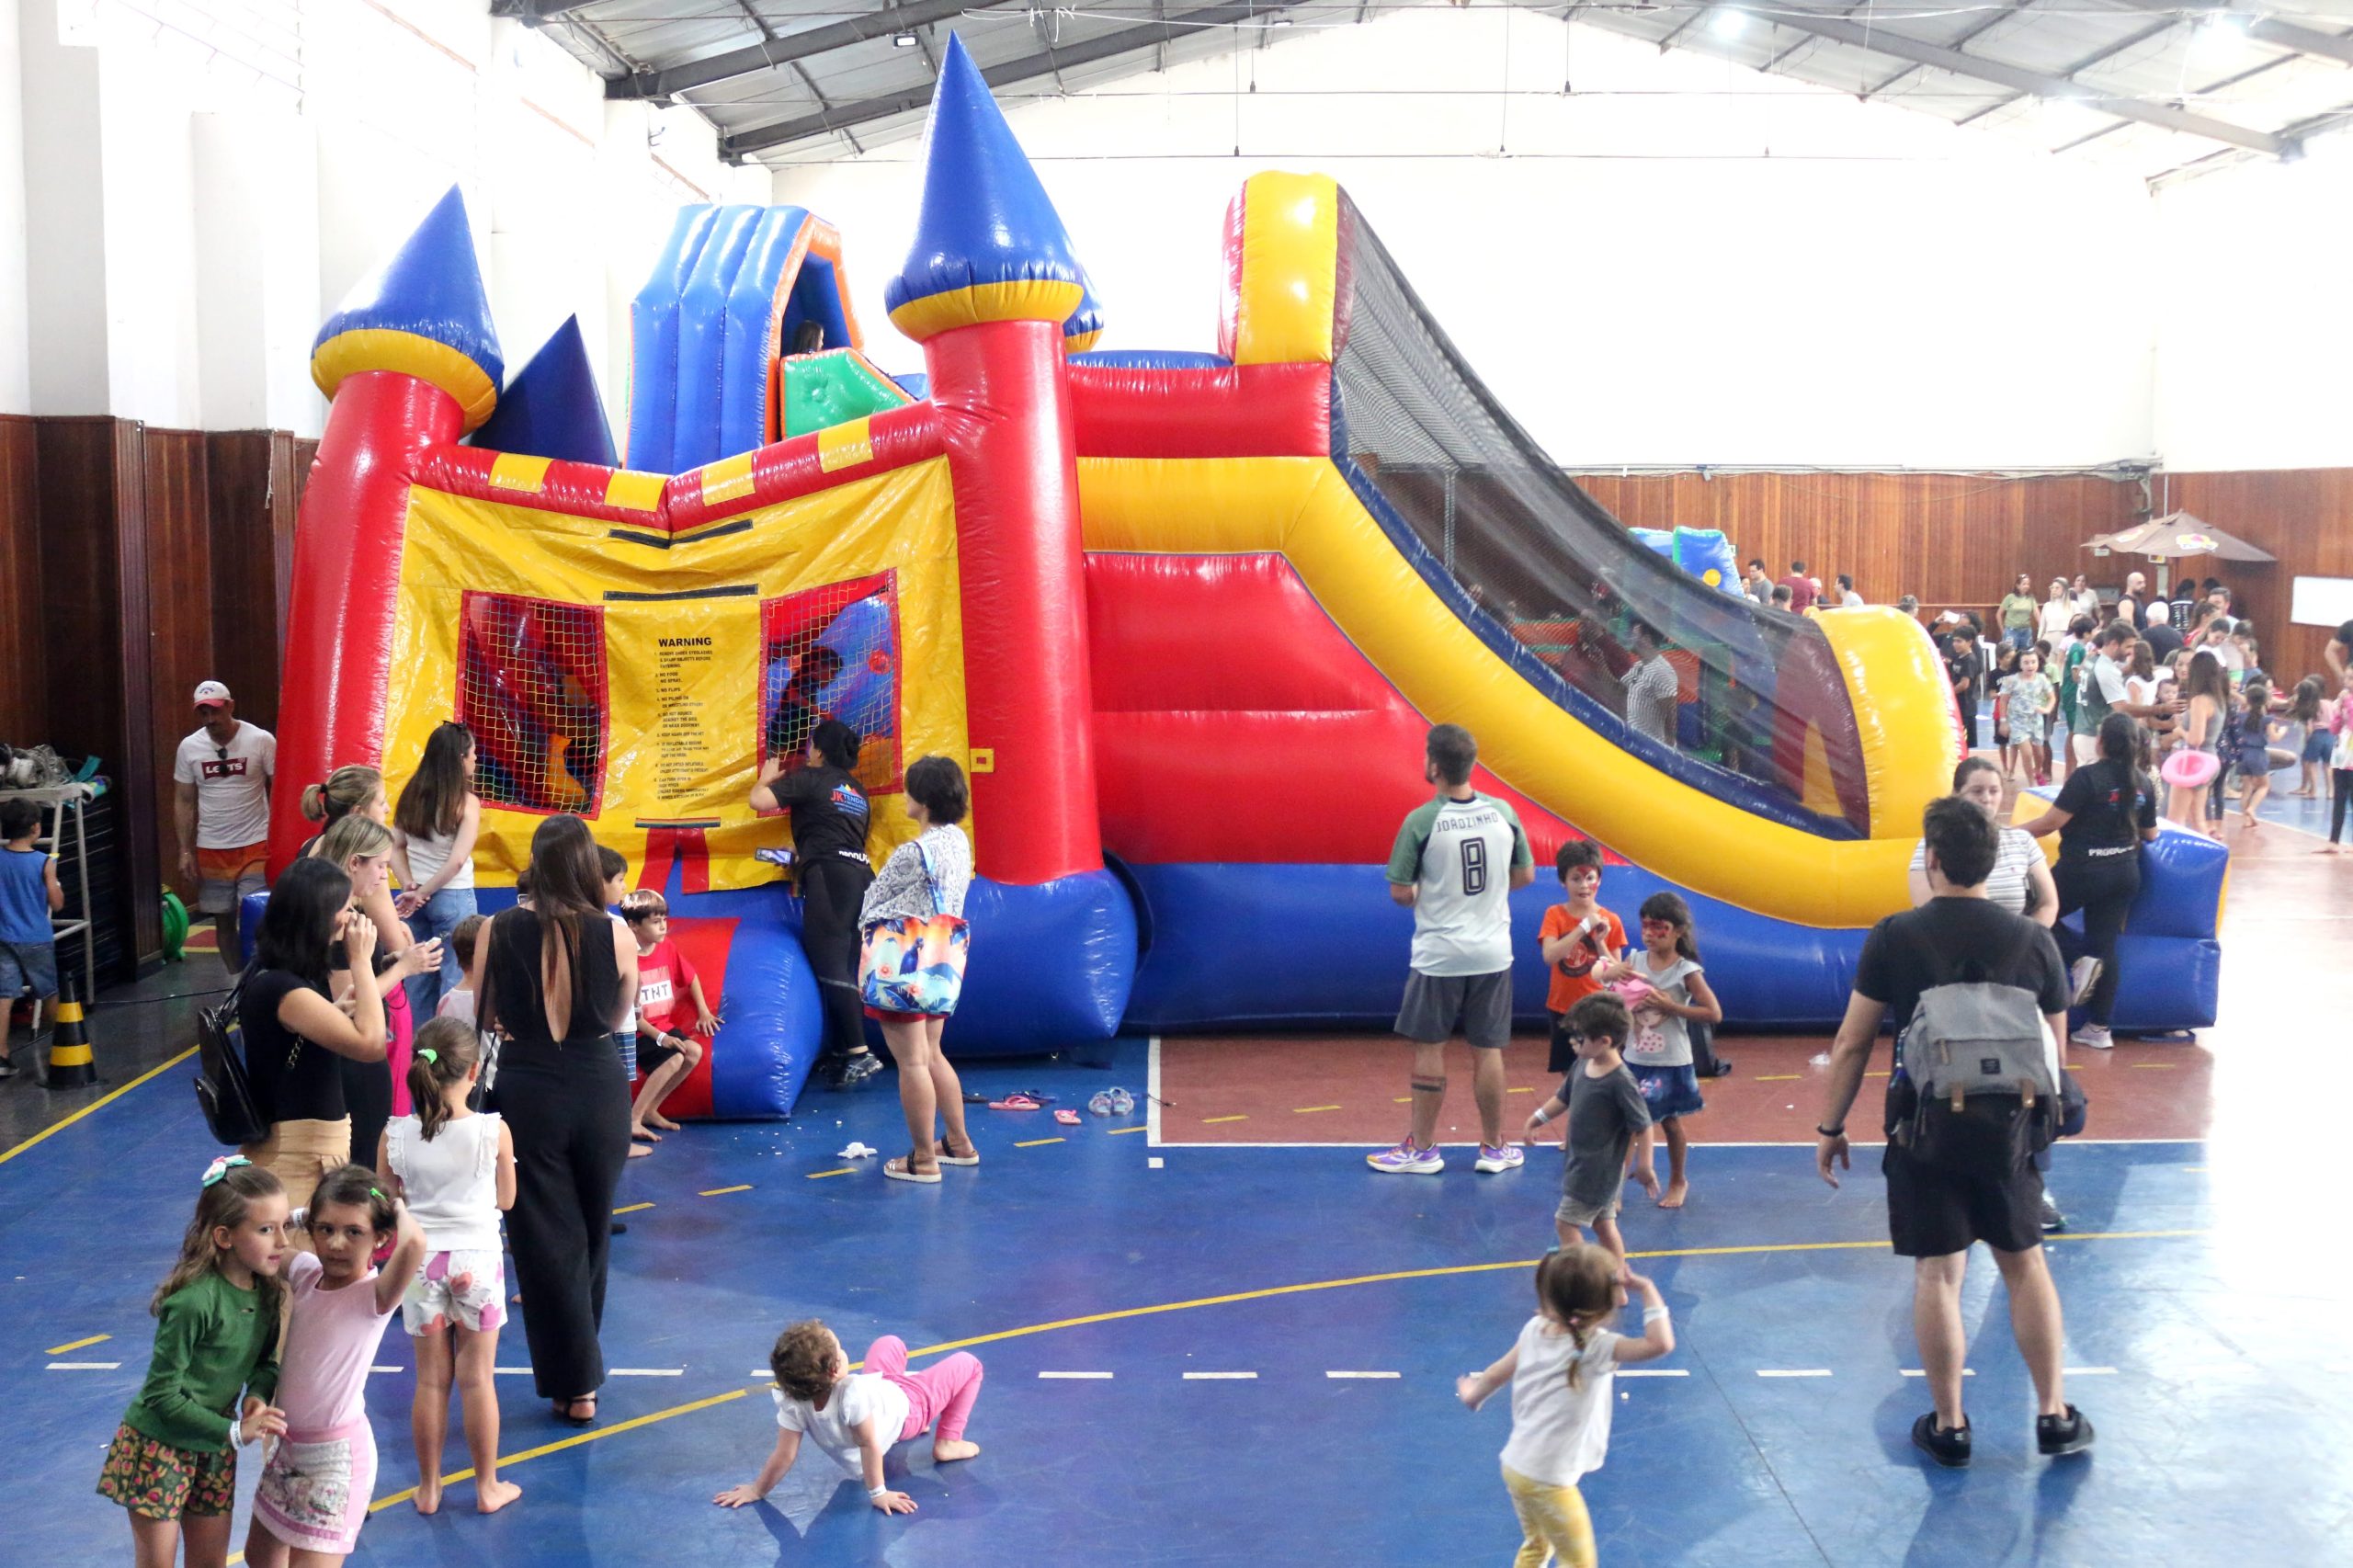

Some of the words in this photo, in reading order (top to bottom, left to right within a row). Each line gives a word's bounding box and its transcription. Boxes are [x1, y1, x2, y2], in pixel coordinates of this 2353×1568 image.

[658, 637, 712, 647] WARNING
[830, 790, 843, 802] JK
[1461, 837, 1486, 895] 8
[641, 983, 667, 1001] TNT
